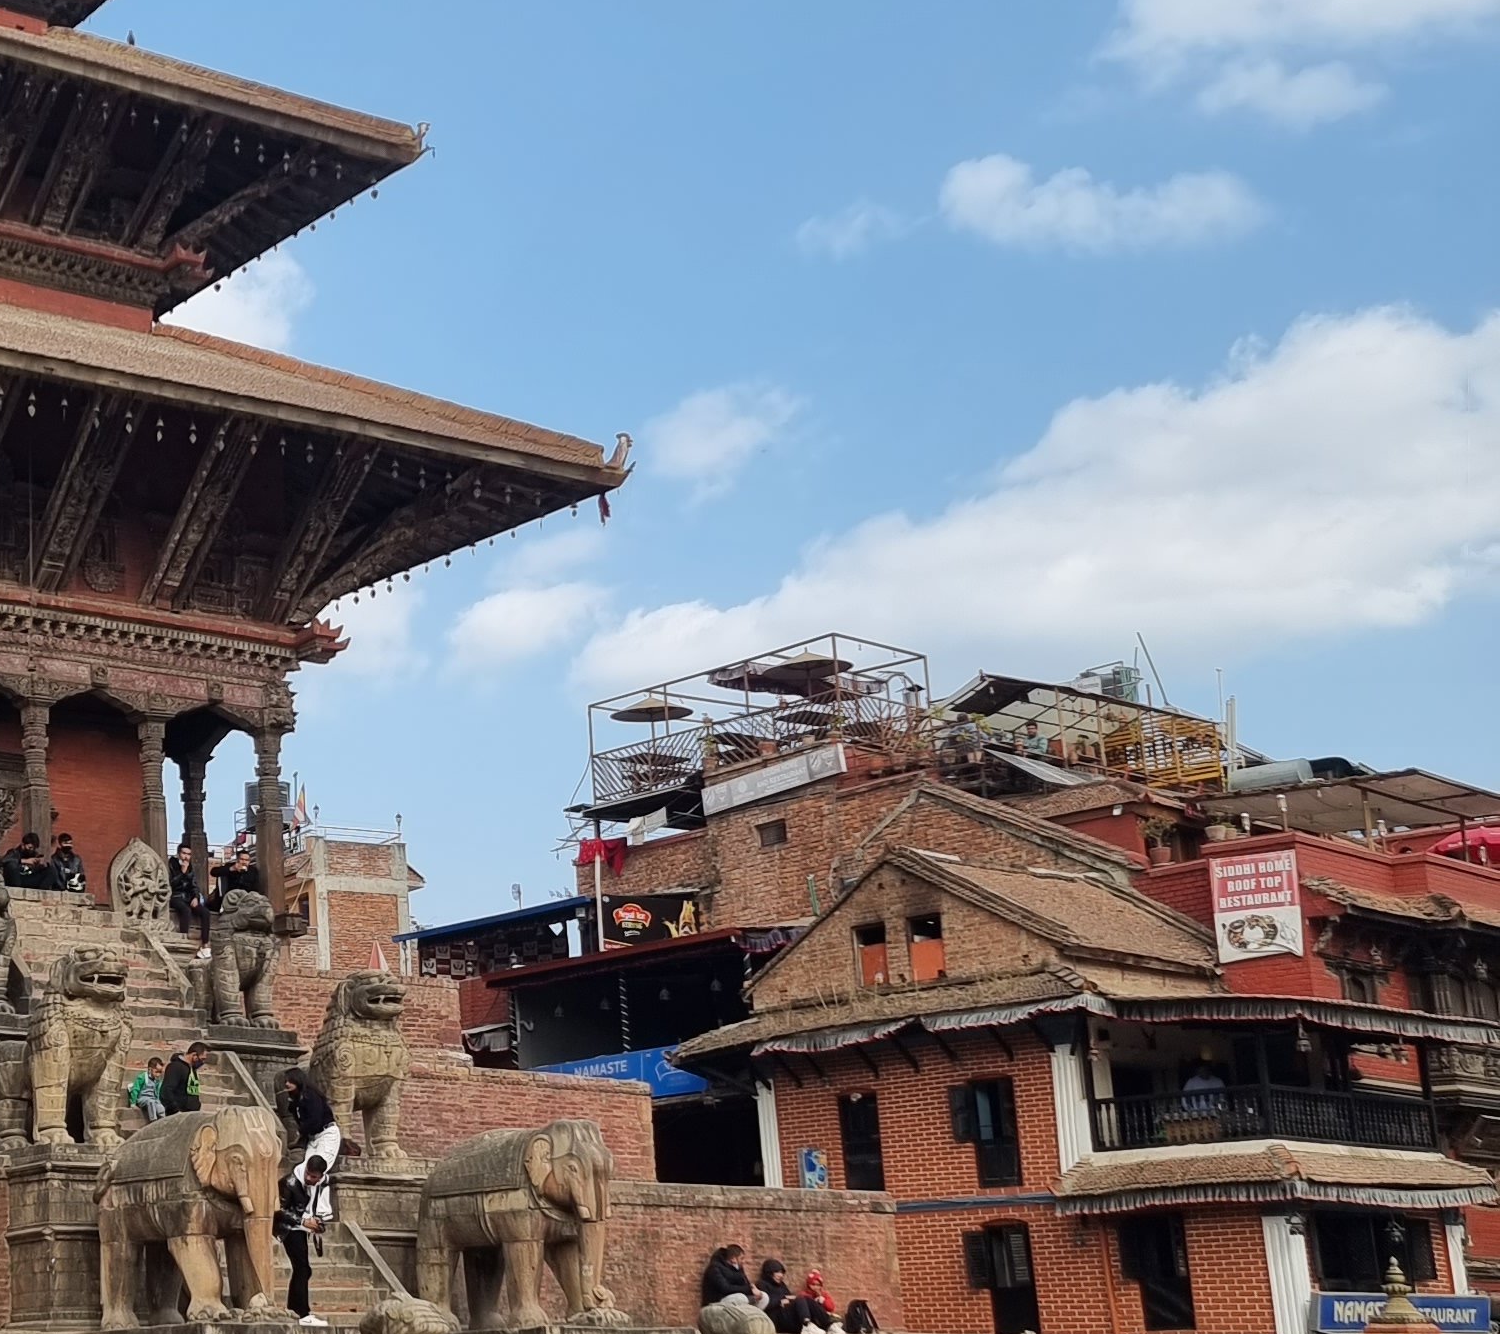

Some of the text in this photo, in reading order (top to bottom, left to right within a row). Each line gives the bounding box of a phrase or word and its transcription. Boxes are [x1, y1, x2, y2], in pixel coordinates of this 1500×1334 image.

[1214, 858, 1292, 879] SIDDHI HOME
[1227, 876, 1282, 892] ROOF TOP
[1219, 891, 1292, 908] RESTAURANT
[574, 1059, 628, 1079] NAMASTE
